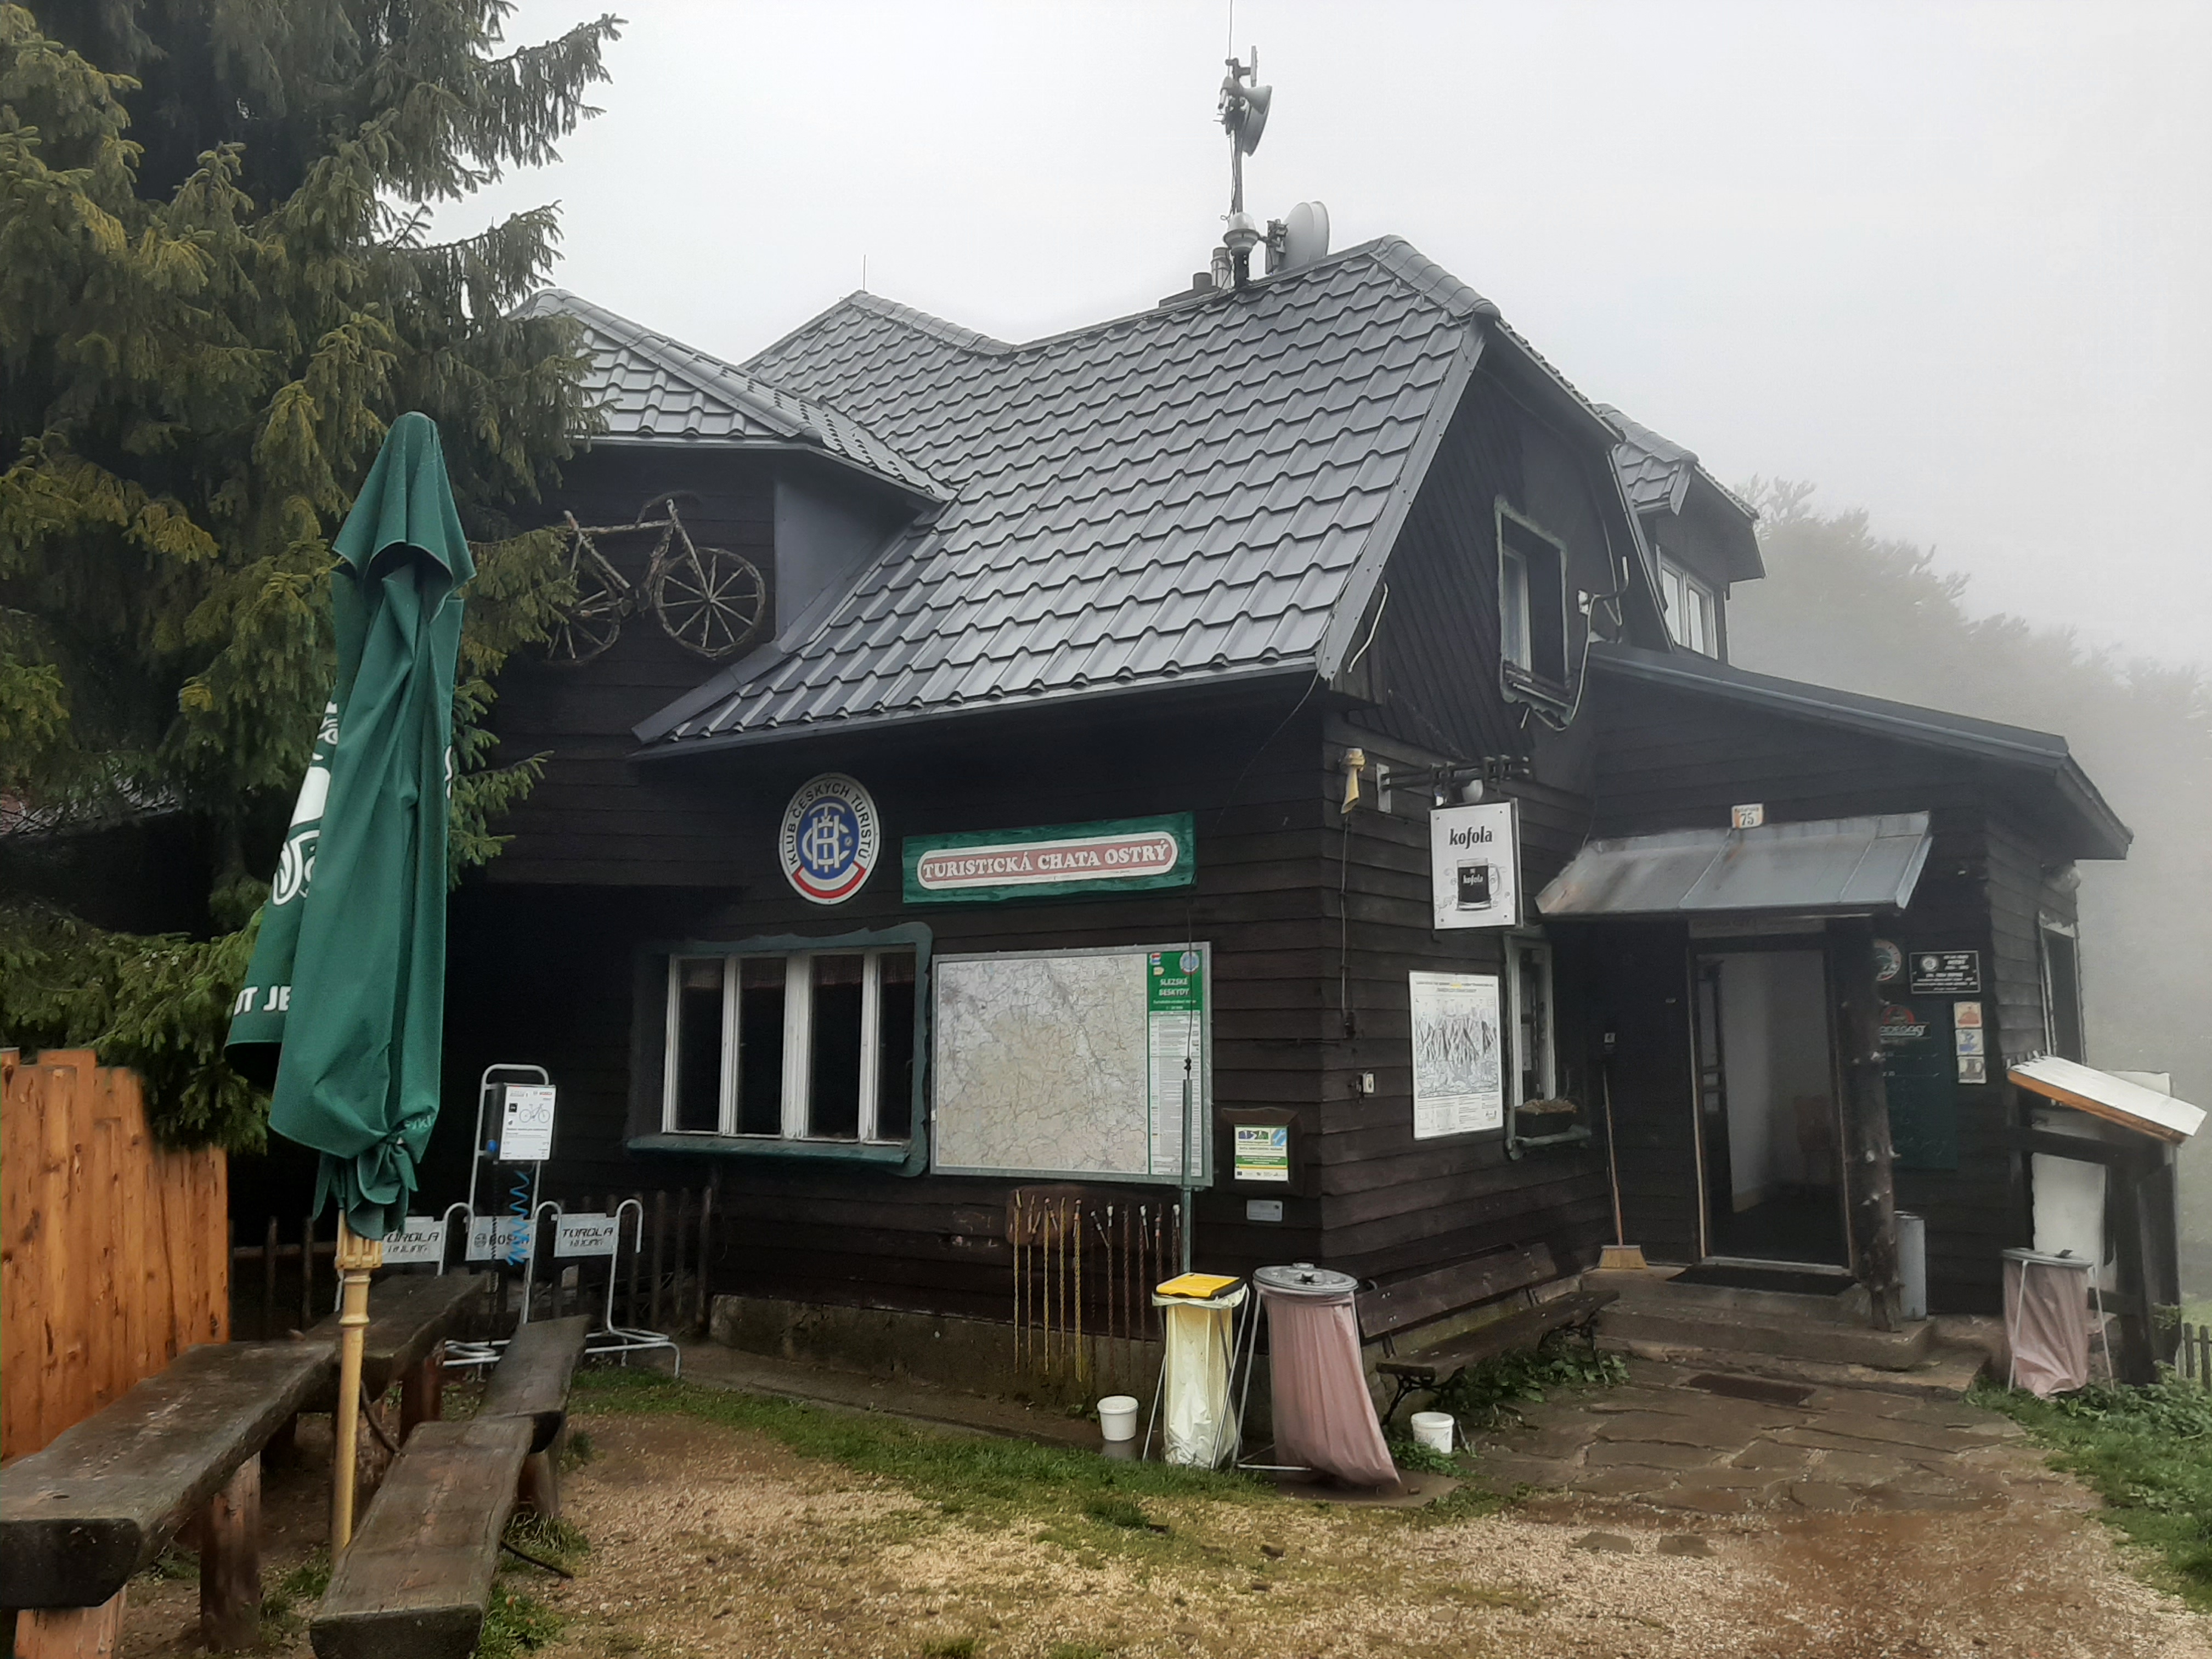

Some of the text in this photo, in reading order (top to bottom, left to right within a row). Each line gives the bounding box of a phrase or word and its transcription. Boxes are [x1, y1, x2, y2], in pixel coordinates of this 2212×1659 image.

[785, 823, 798, 866] KLUB
[851, 793, 872, 860] TURISTŮ
[1740, 812, 1754, 826] 75
[1449, 825, 1493, 850] kofola
[923, 839, 1169, 878] TURISTICKÁ CHATA OSTRÝ
[1462, 873, 1483, 886] kofola
